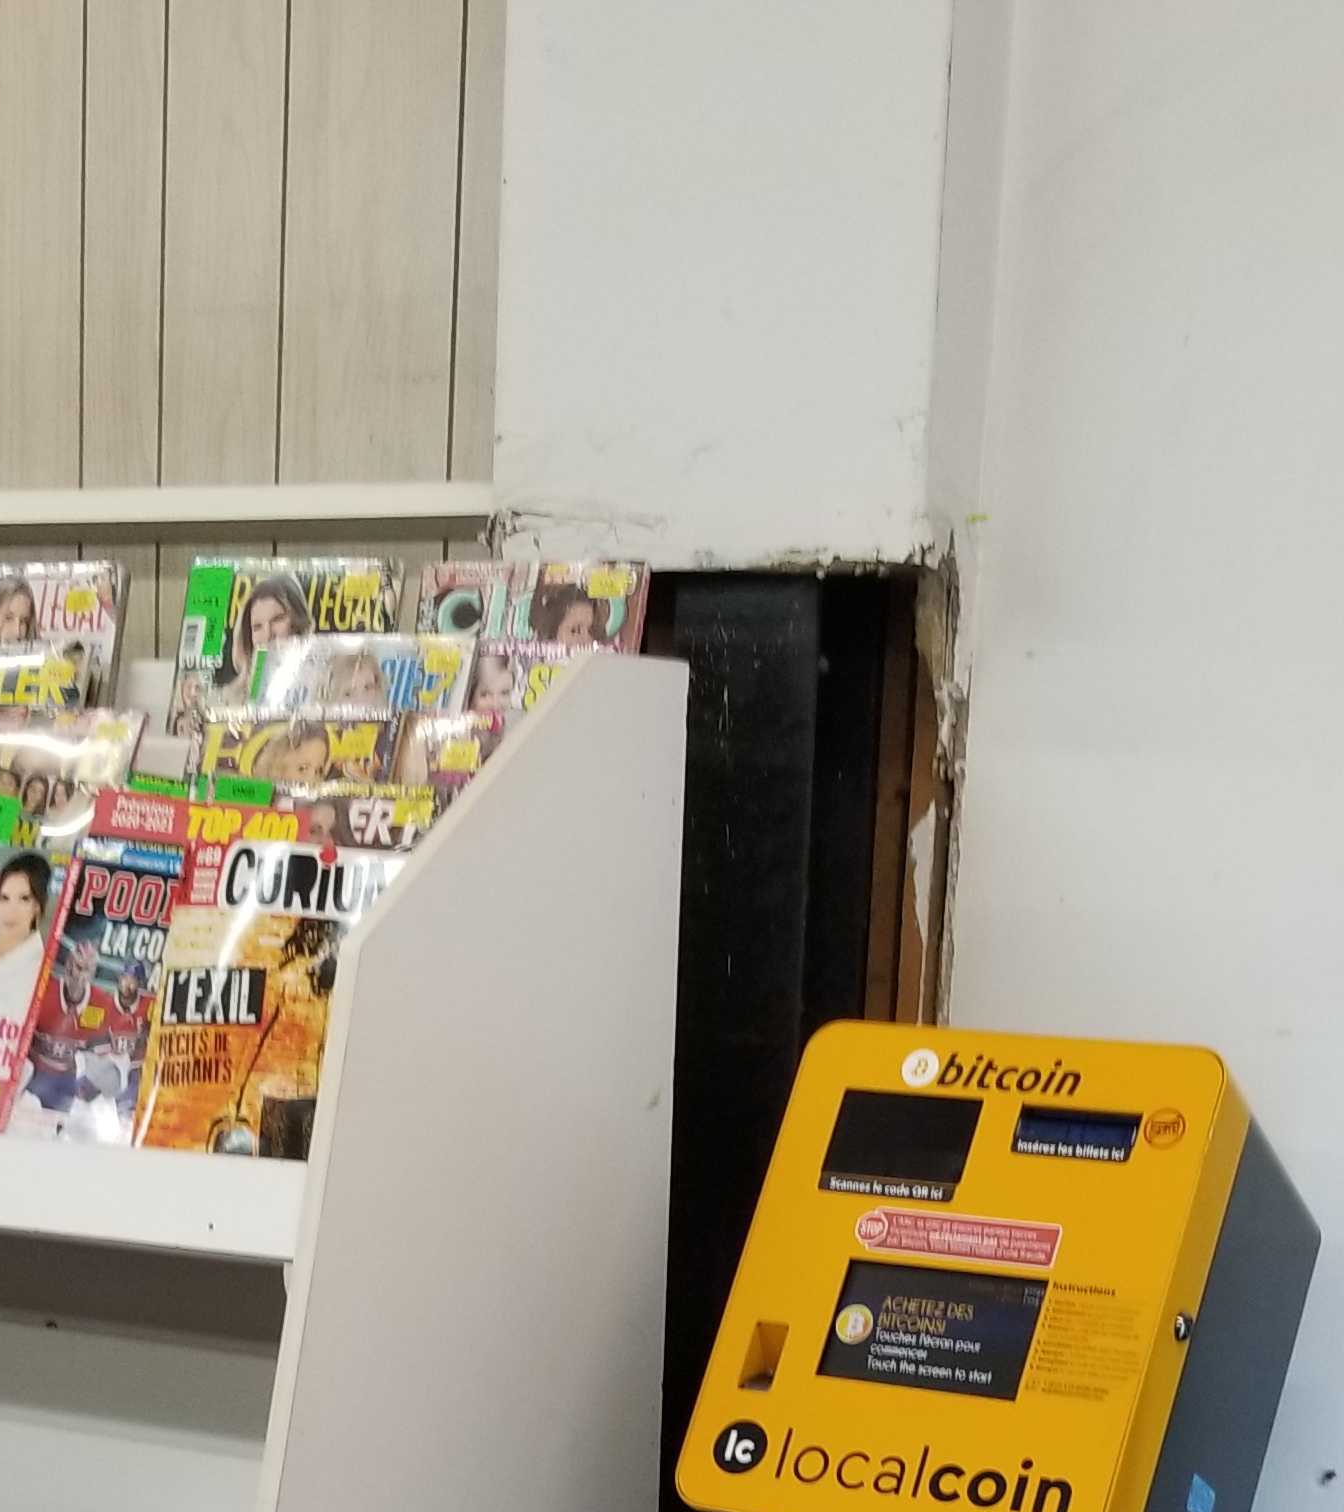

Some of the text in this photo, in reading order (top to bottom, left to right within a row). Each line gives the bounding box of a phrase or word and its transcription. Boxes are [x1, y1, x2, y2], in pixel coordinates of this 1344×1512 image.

[187, 806, 242, 844] TOP
[163, 968, 256, 1025] L'EXIL
[937, 1052, 1083, 1097] bitcoin
[1058, 1141, 1074, 1157] les
[1076, 1143, 1109, 1159] billets
[1111, 1147, 1125, 1161] ici
[829, 1176, 871, 1193] Scannez
[884, 1182, 910, 1197] code
[912, 1184, 929, 1199] QR
[930, 1186, 944, 1200] ici
[883, 1296, 975, 1322] ACHETEZ DES
[956, 1339, 982, 1354] pour
[867, 1355, 993, 1386] Touch the screen to start
